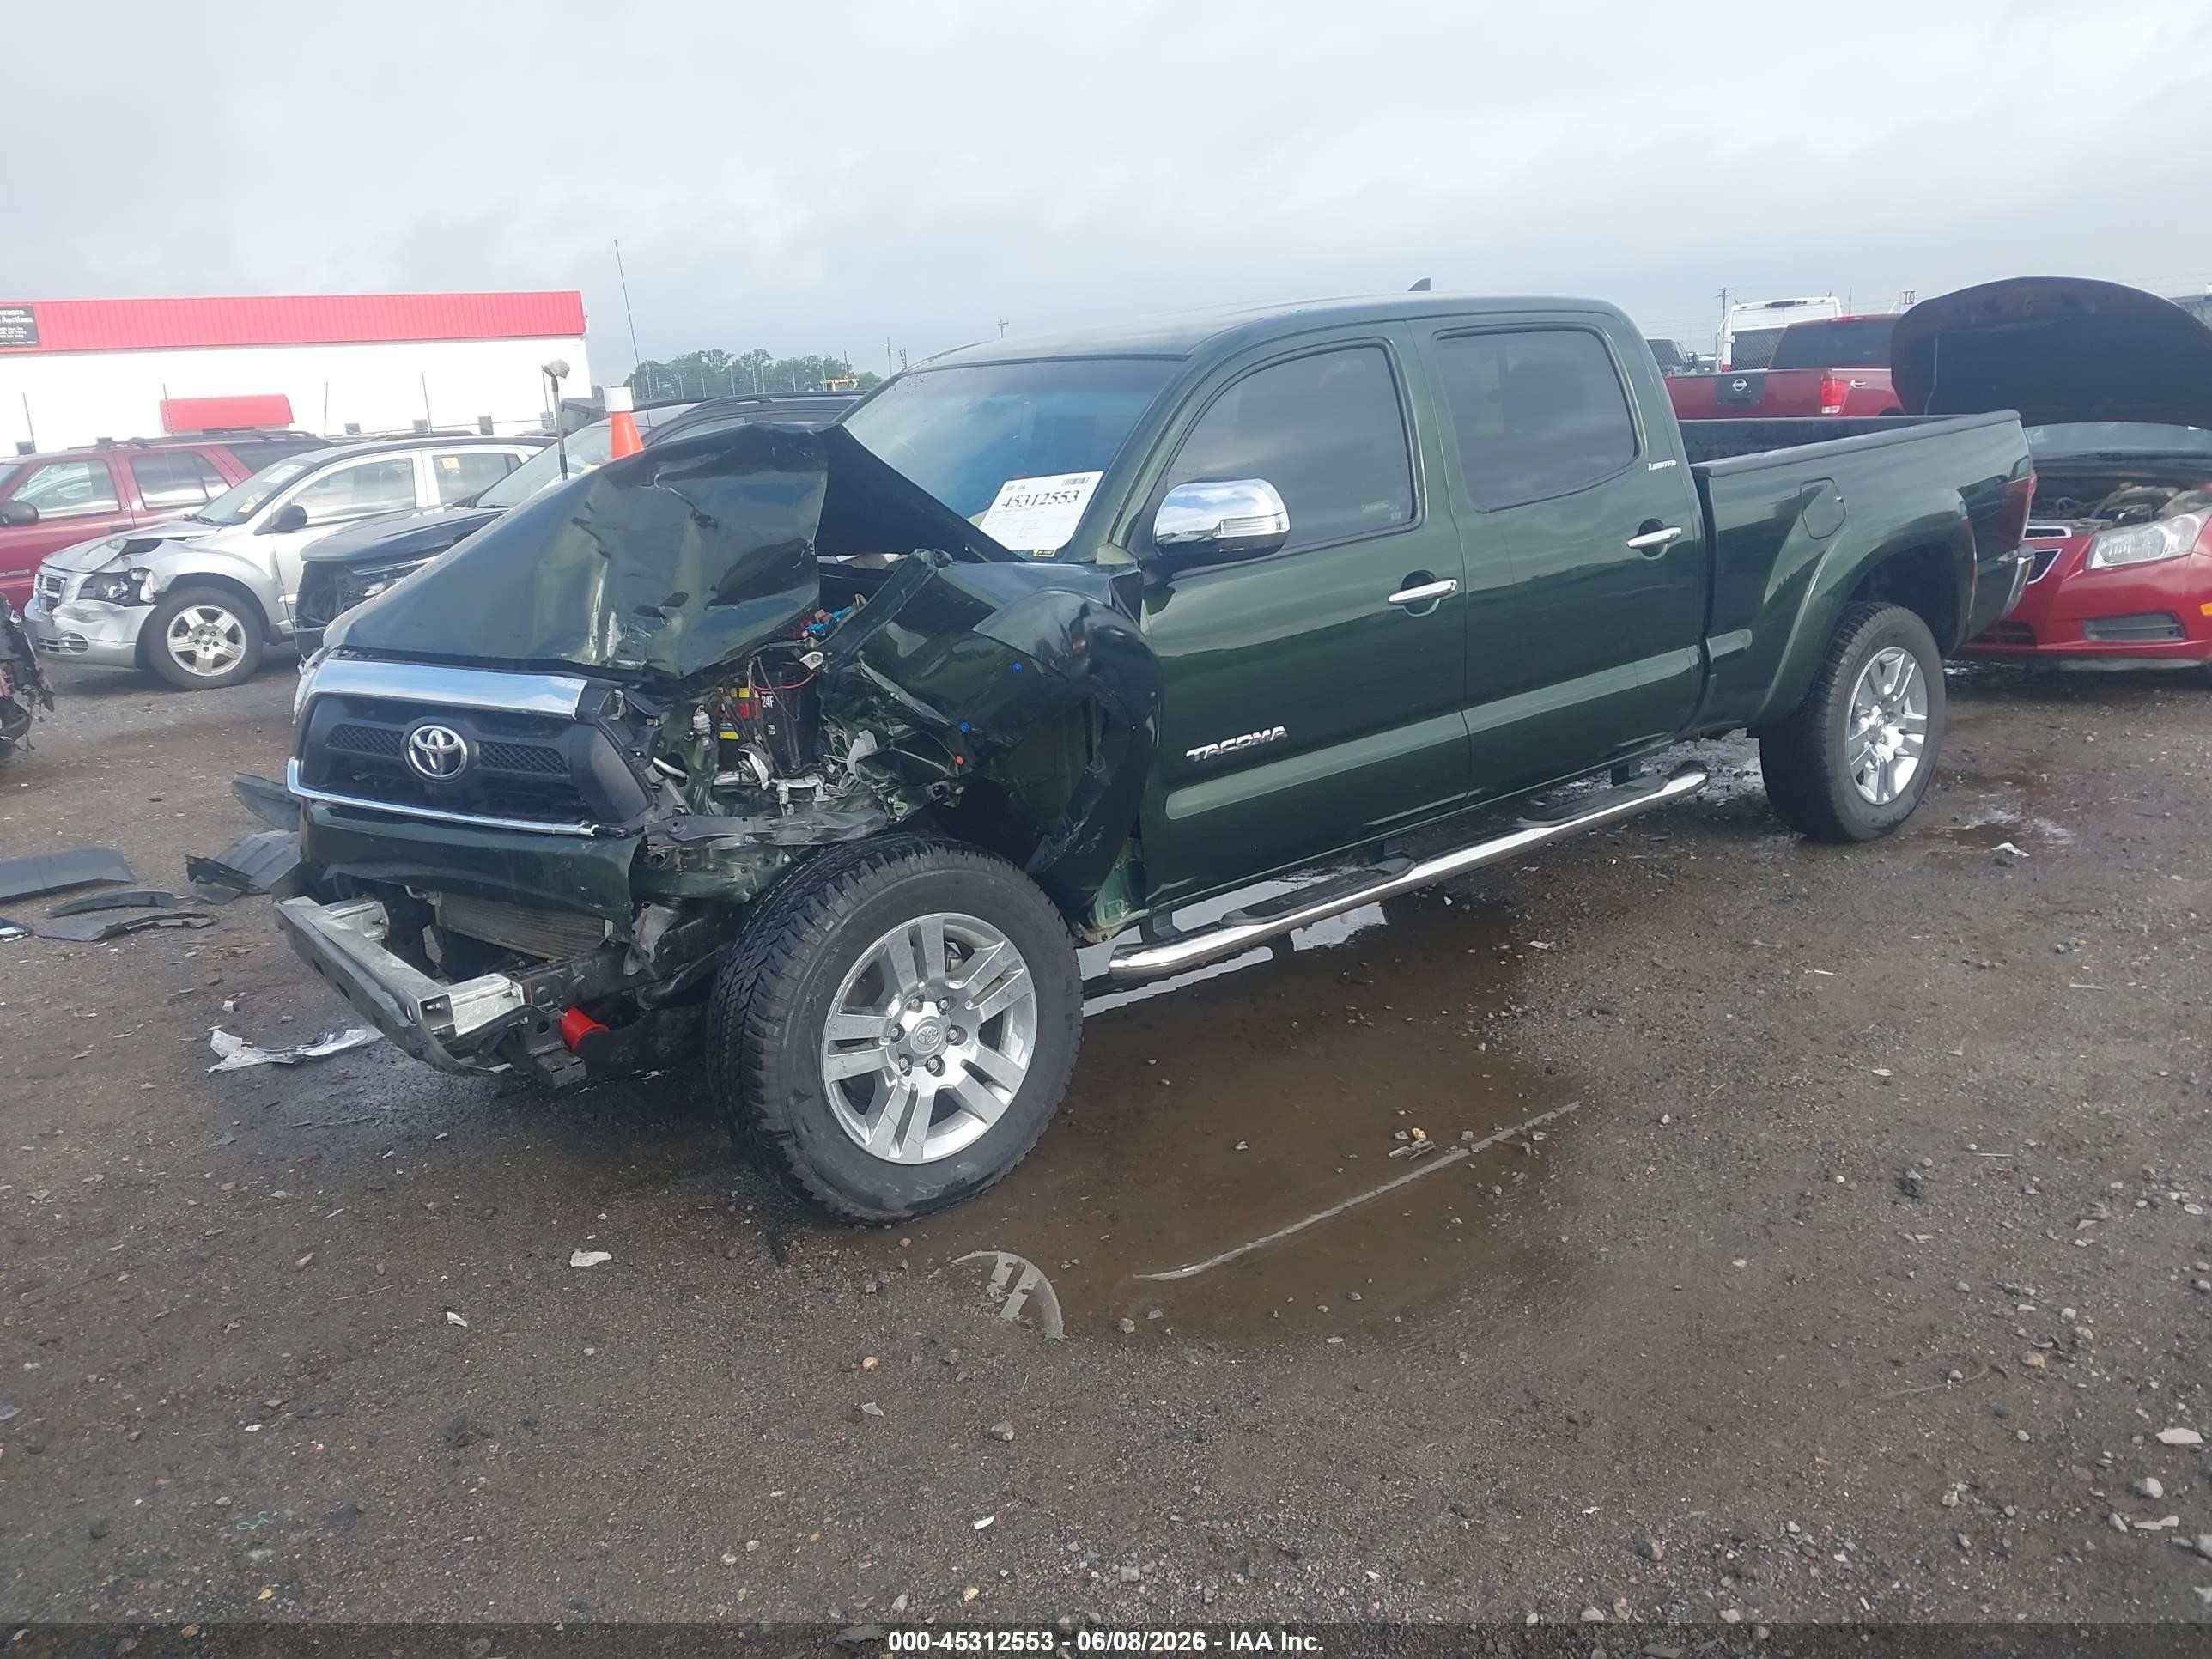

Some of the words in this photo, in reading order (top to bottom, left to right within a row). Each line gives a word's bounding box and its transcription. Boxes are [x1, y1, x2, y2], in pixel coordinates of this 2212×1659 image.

[1001, 489, 1080, 508] 45312553
[761, 695, 774, 708] 24F
[1186, 725, 1288, 762] TACOMA
